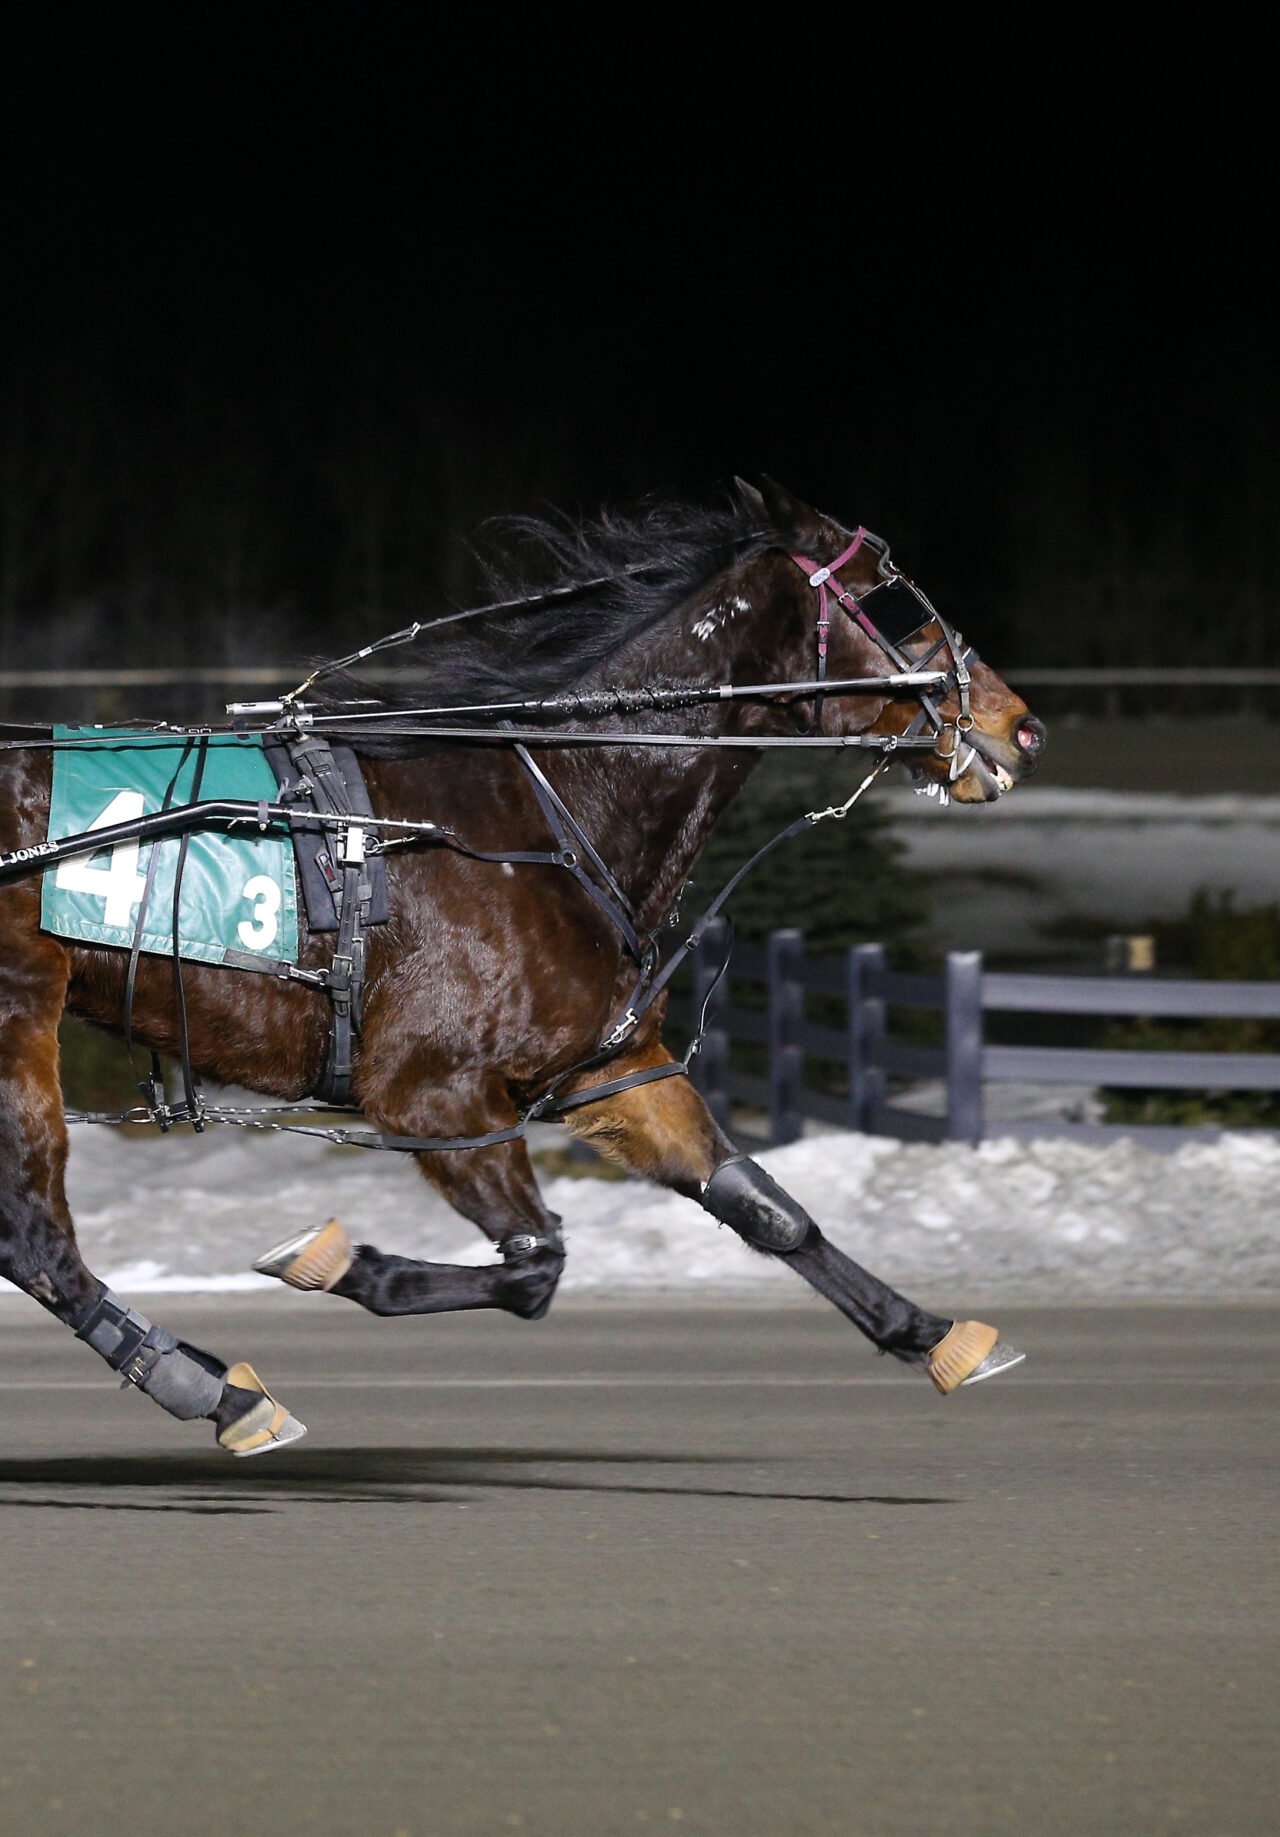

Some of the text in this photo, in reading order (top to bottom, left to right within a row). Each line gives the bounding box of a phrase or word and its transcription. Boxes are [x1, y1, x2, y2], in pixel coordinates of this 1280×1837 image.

[9, 841, 60, 864] JONES
[56, 791, 147, 928] 4
[237, 874, 281, 951] 3
